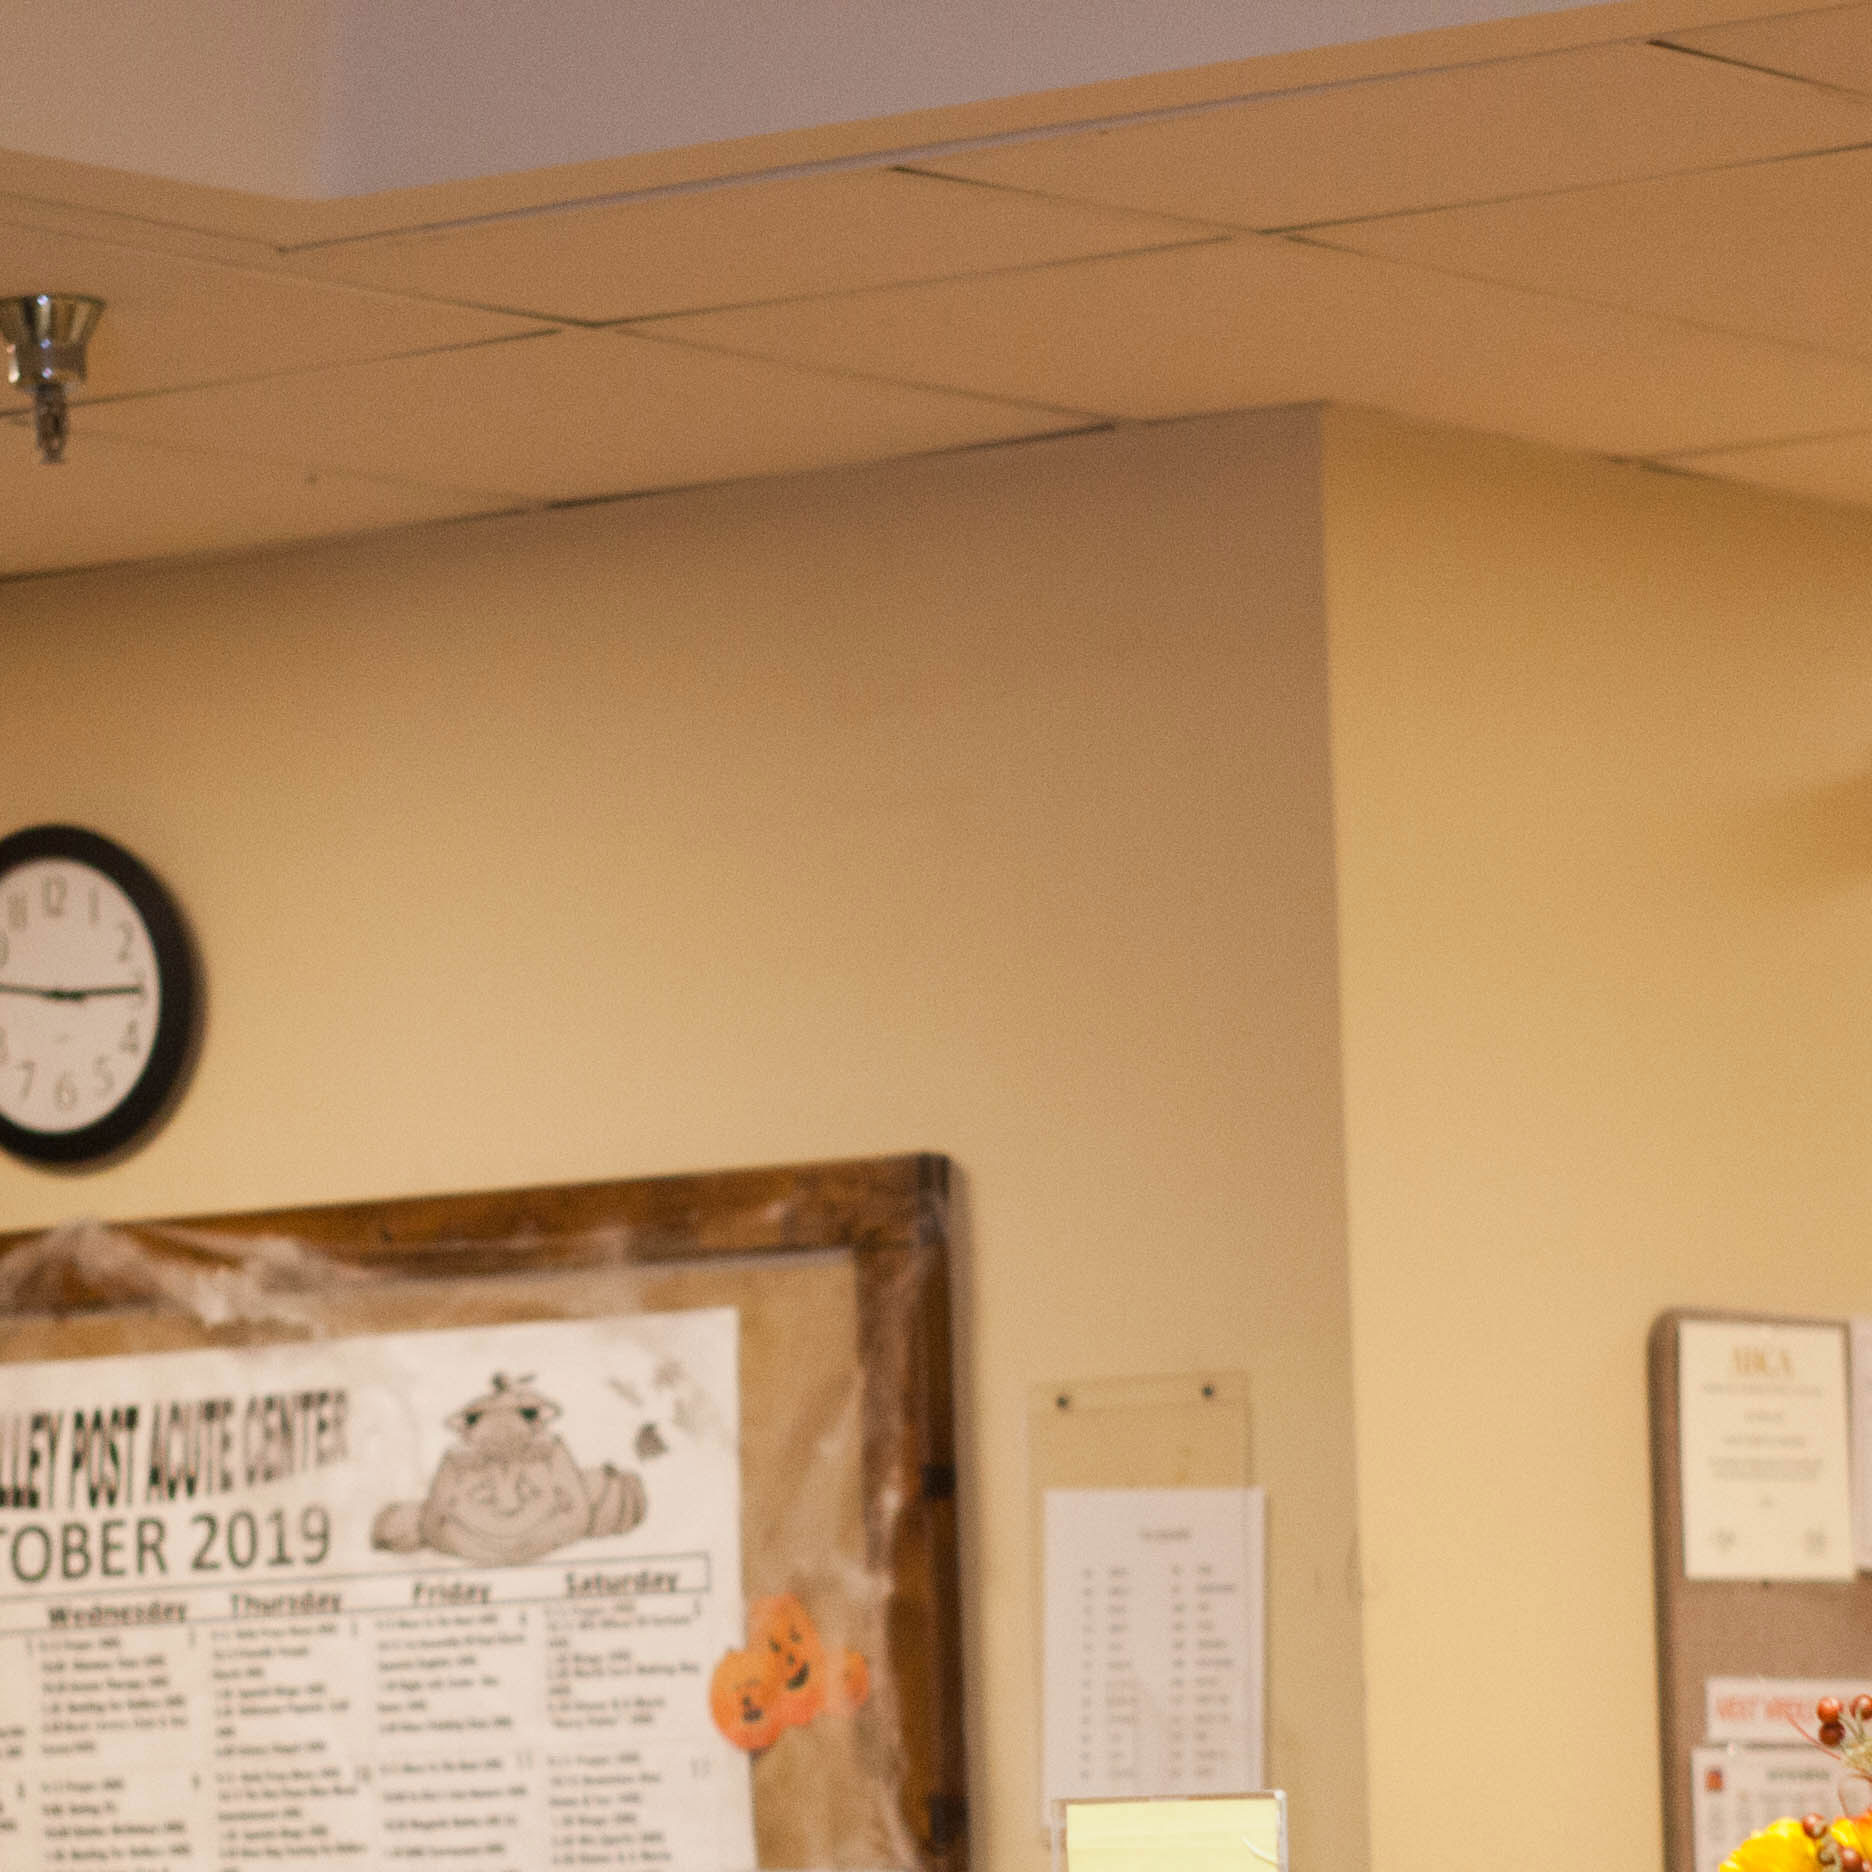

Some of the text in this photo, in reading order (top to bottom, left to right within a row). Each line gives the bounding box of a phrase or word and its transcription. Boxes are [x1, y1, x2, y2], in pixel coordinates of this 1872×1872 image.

[67, 1402, 141, 1508] POST
[145, 1398, 235, 1503] ACUTE
[243, 1390, 349, 1488] CENTER
[188, 1504, 334, 1573] 2019
